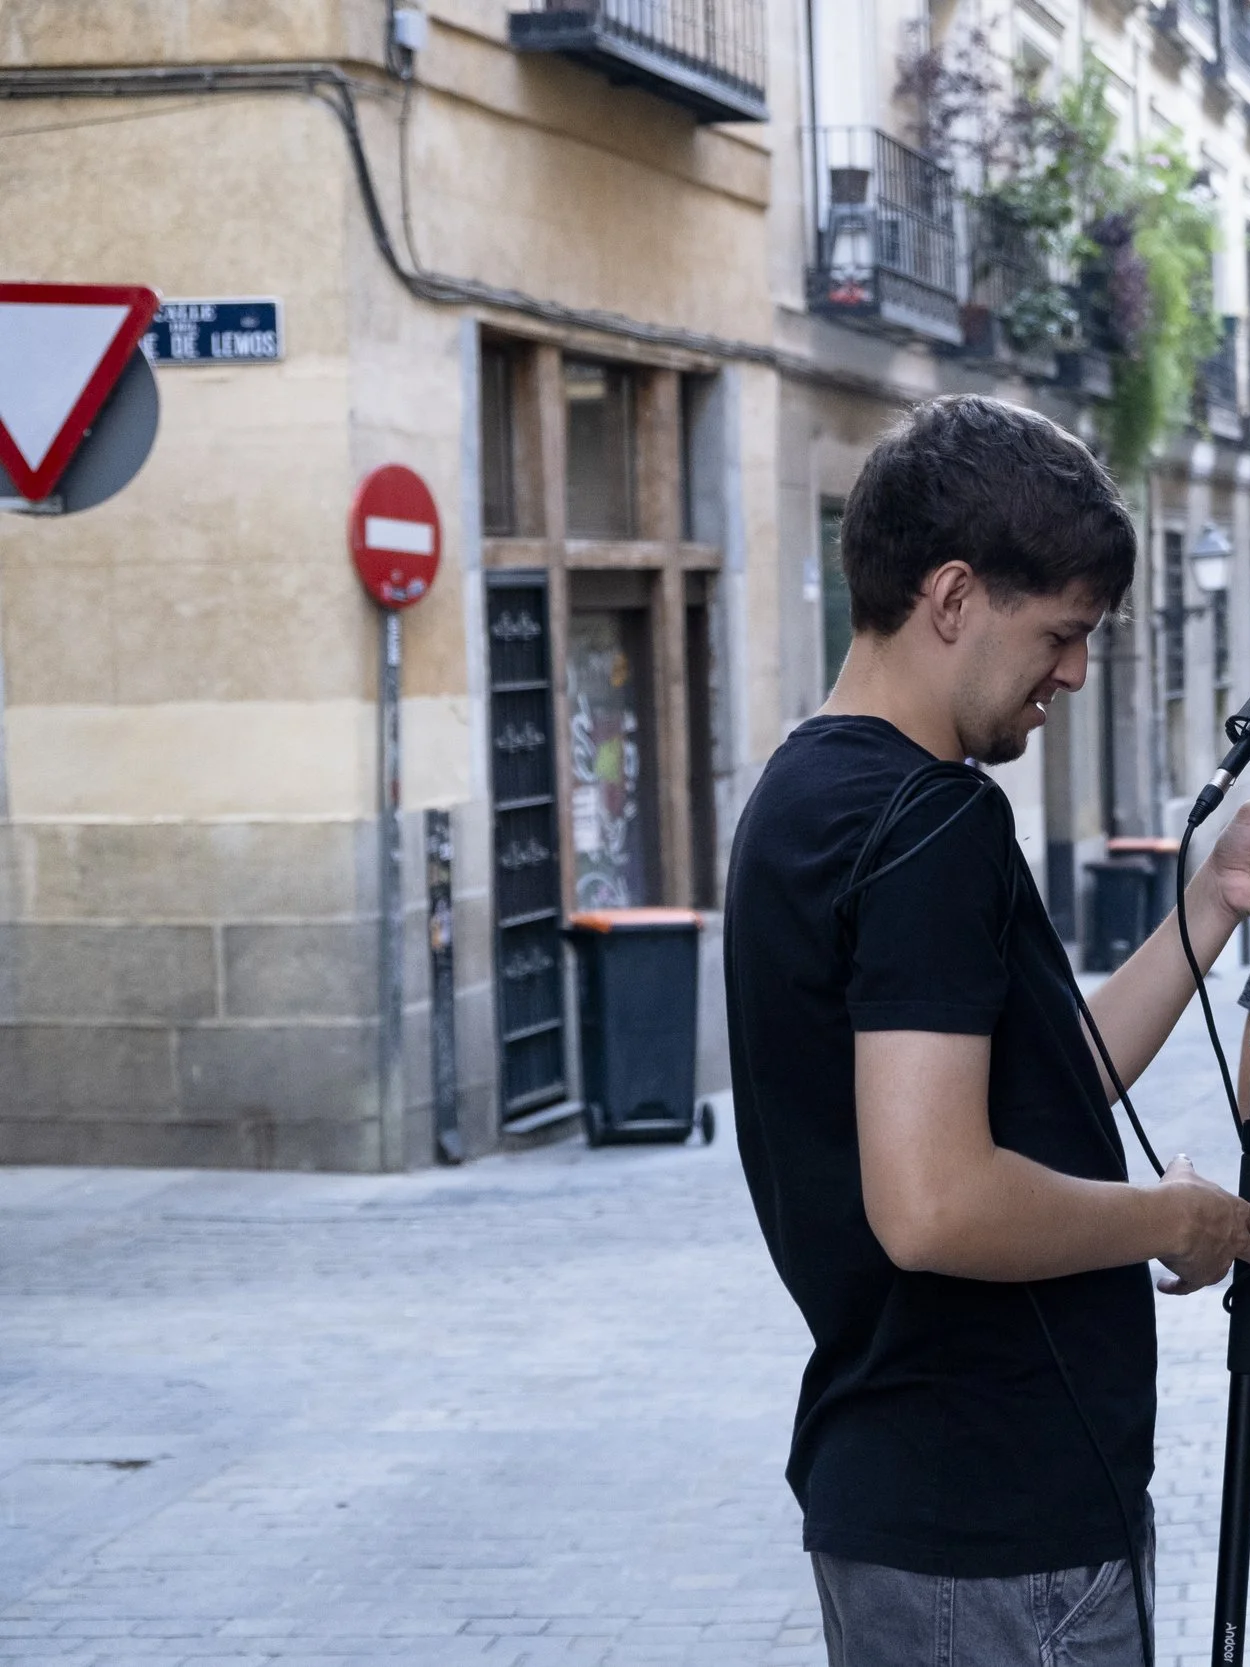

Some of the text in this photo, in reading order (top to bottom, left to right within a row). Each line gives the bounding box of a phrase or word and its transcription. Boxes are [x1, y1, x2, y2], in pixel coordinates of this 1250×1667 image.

[170, 332, 200, 358] DE
[211, 330, 277, 358] LEMOS
[1224, 1622, 1237, 1663] Andoer
